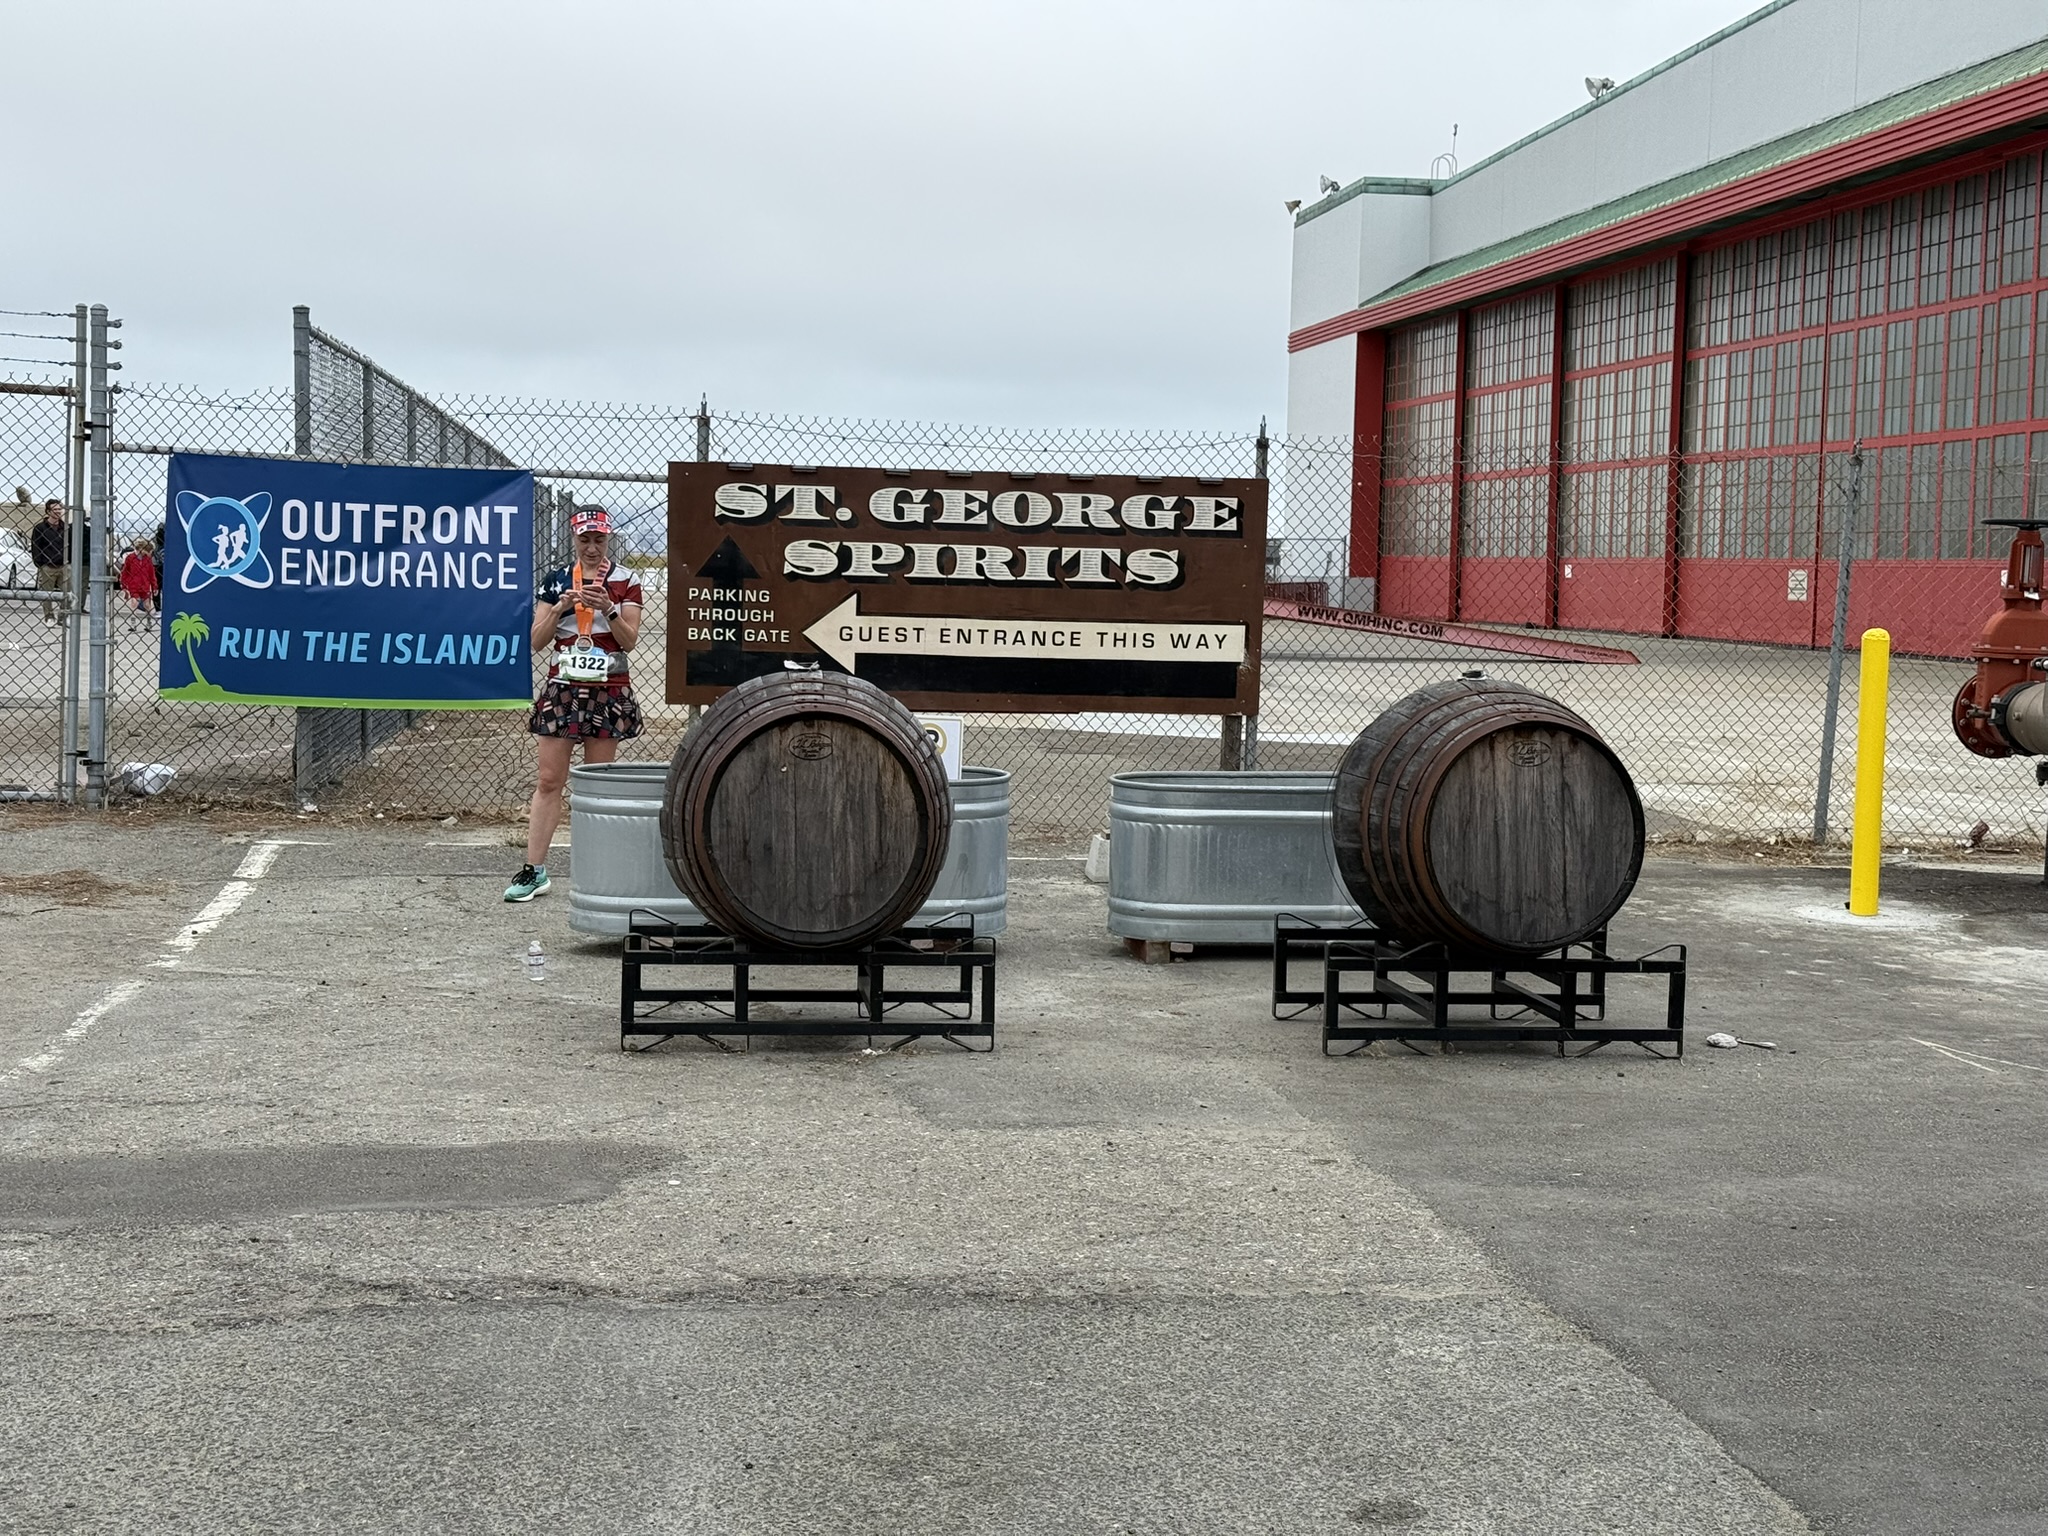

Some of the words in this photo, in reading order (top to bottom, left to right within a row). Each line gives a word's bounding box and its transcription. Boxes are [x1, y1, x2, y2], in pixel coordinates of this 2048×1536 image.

[281, 498, 519, 545] OUTFRONT
[714, 482, 853, 522] ST.
[868, 487, 1239, 532] GEORGE
[281, 547, 518, 590] ENDURANCE
[783, 539, 1180, 585] SPIRITS
[688, 587, 771, 603] PARKING
[688, 607, 775, 623] THROUGH
[219, 626, 291, 661] RUN
[302, 630, 371, 663] THE
[380, 632, 521, 665] ISLAND!
[687, 627, 737, 641] BACK
[744, 628, 791, 643] GATE
[839, 625, 925, 644] GUEST
[939, 627, 1082, 648] ENTRANCE
[1096, 631, 1155, 649] THIS
[1170, 633, 1228, 650] WAY
[571, 655, 606, 671] 1322
